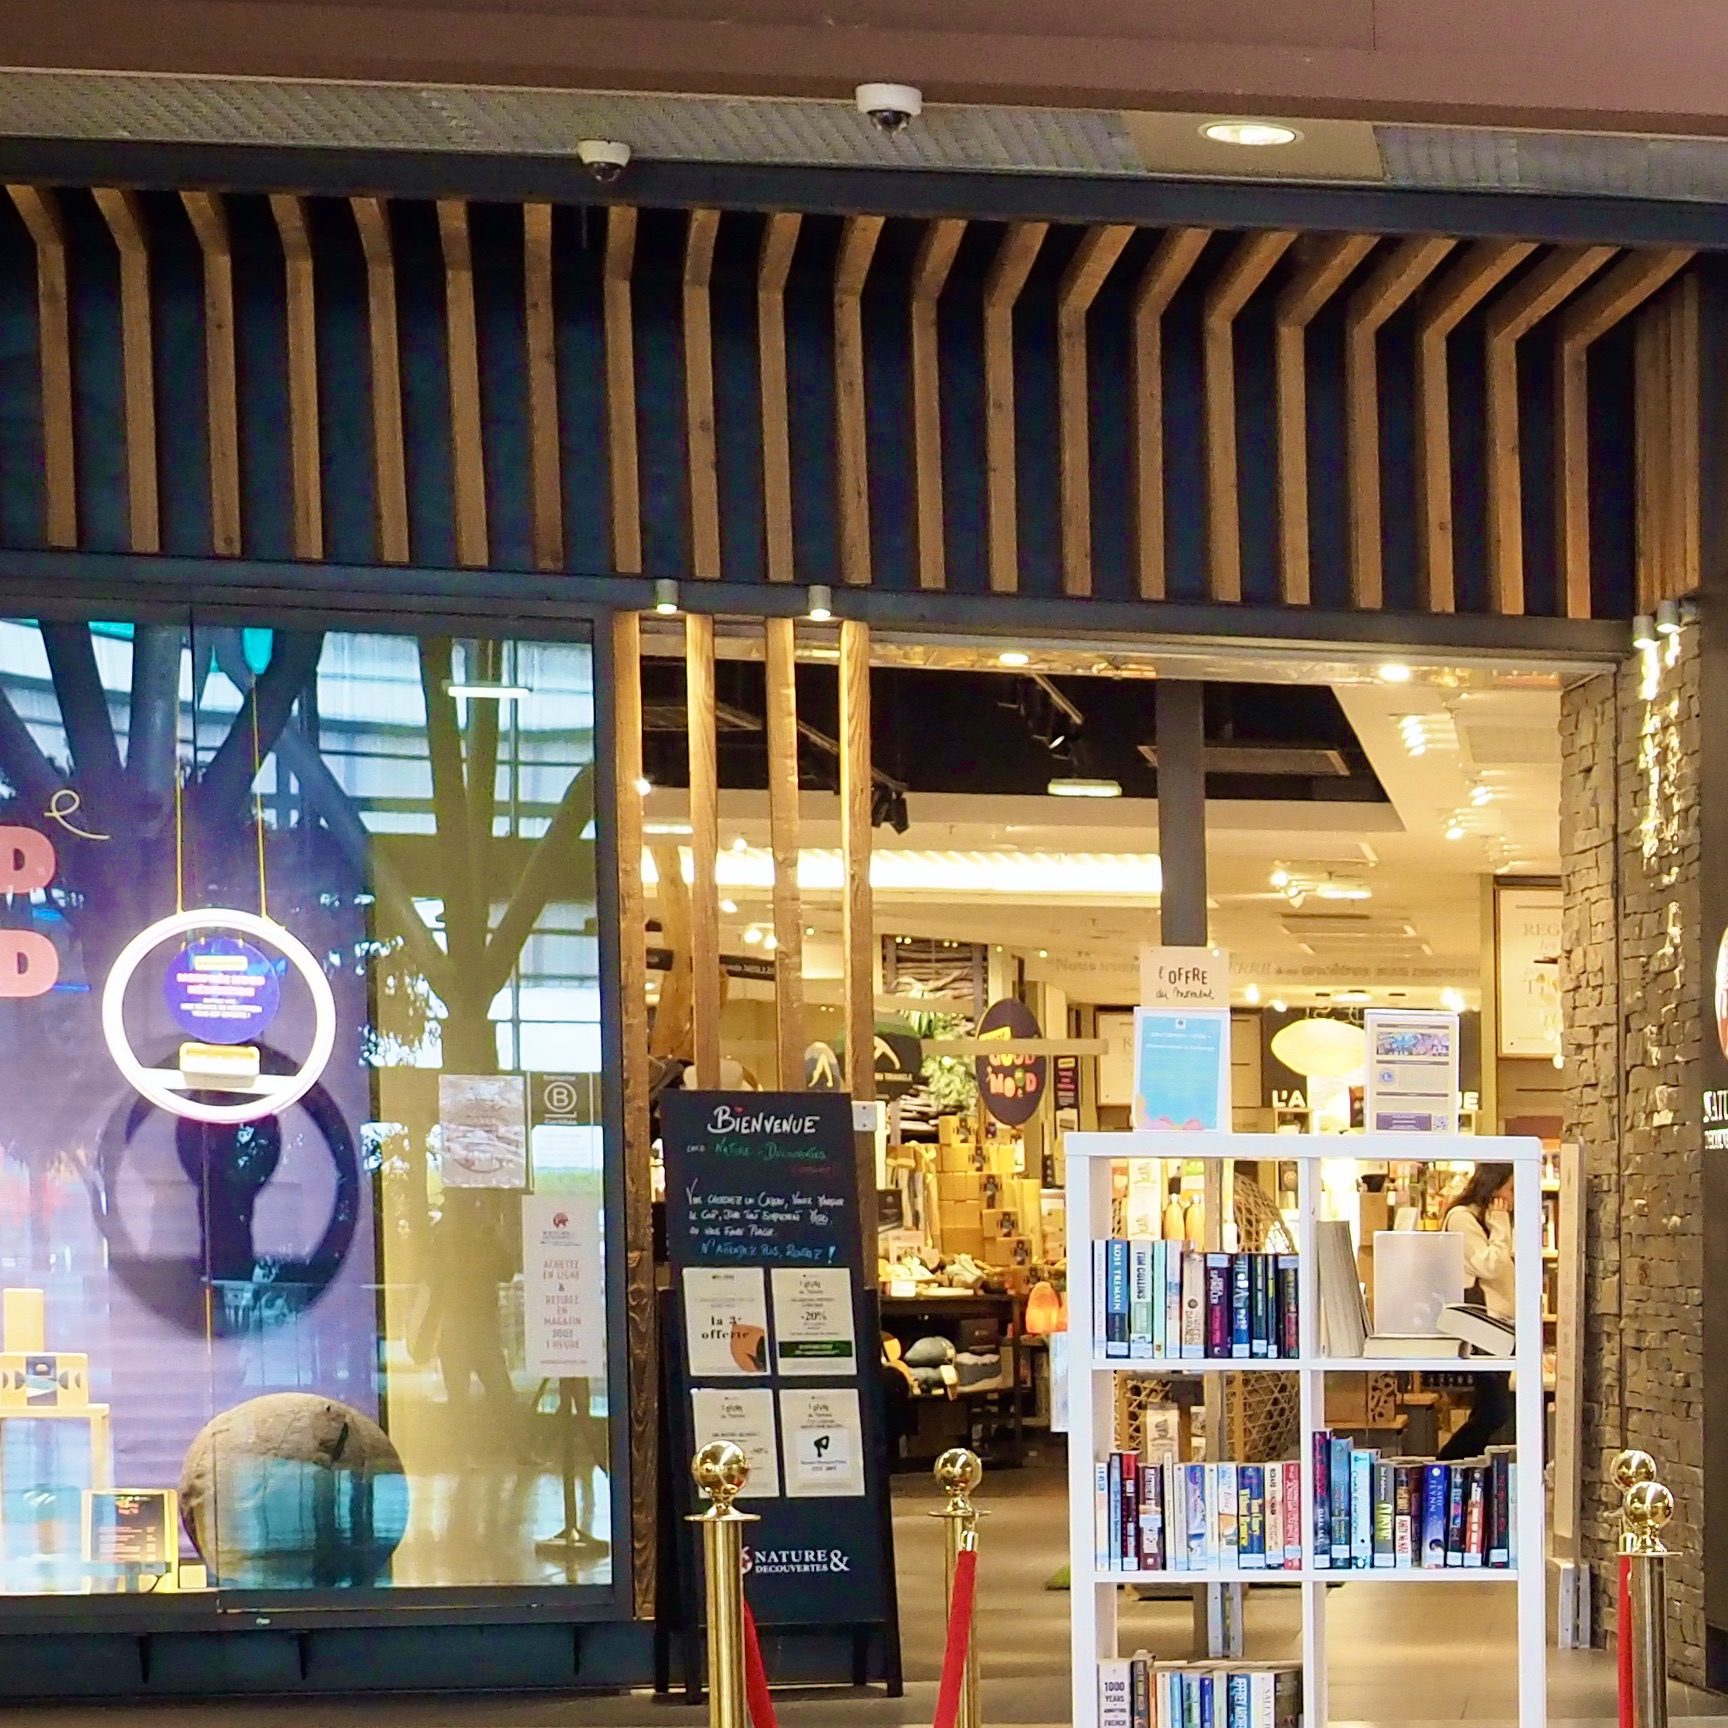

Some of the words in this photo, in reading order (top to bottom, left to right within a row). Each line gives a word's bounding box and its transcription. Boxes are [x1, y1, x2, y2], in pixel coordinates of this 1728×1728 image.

[1113, 1269, 1123, 1311] TREMAIN
[1136, 1267, 1147, 1300] COLLINS
[754, 1549, 829, 1563] NATURE
[1104, 1681, 1125, 1692] 1000
